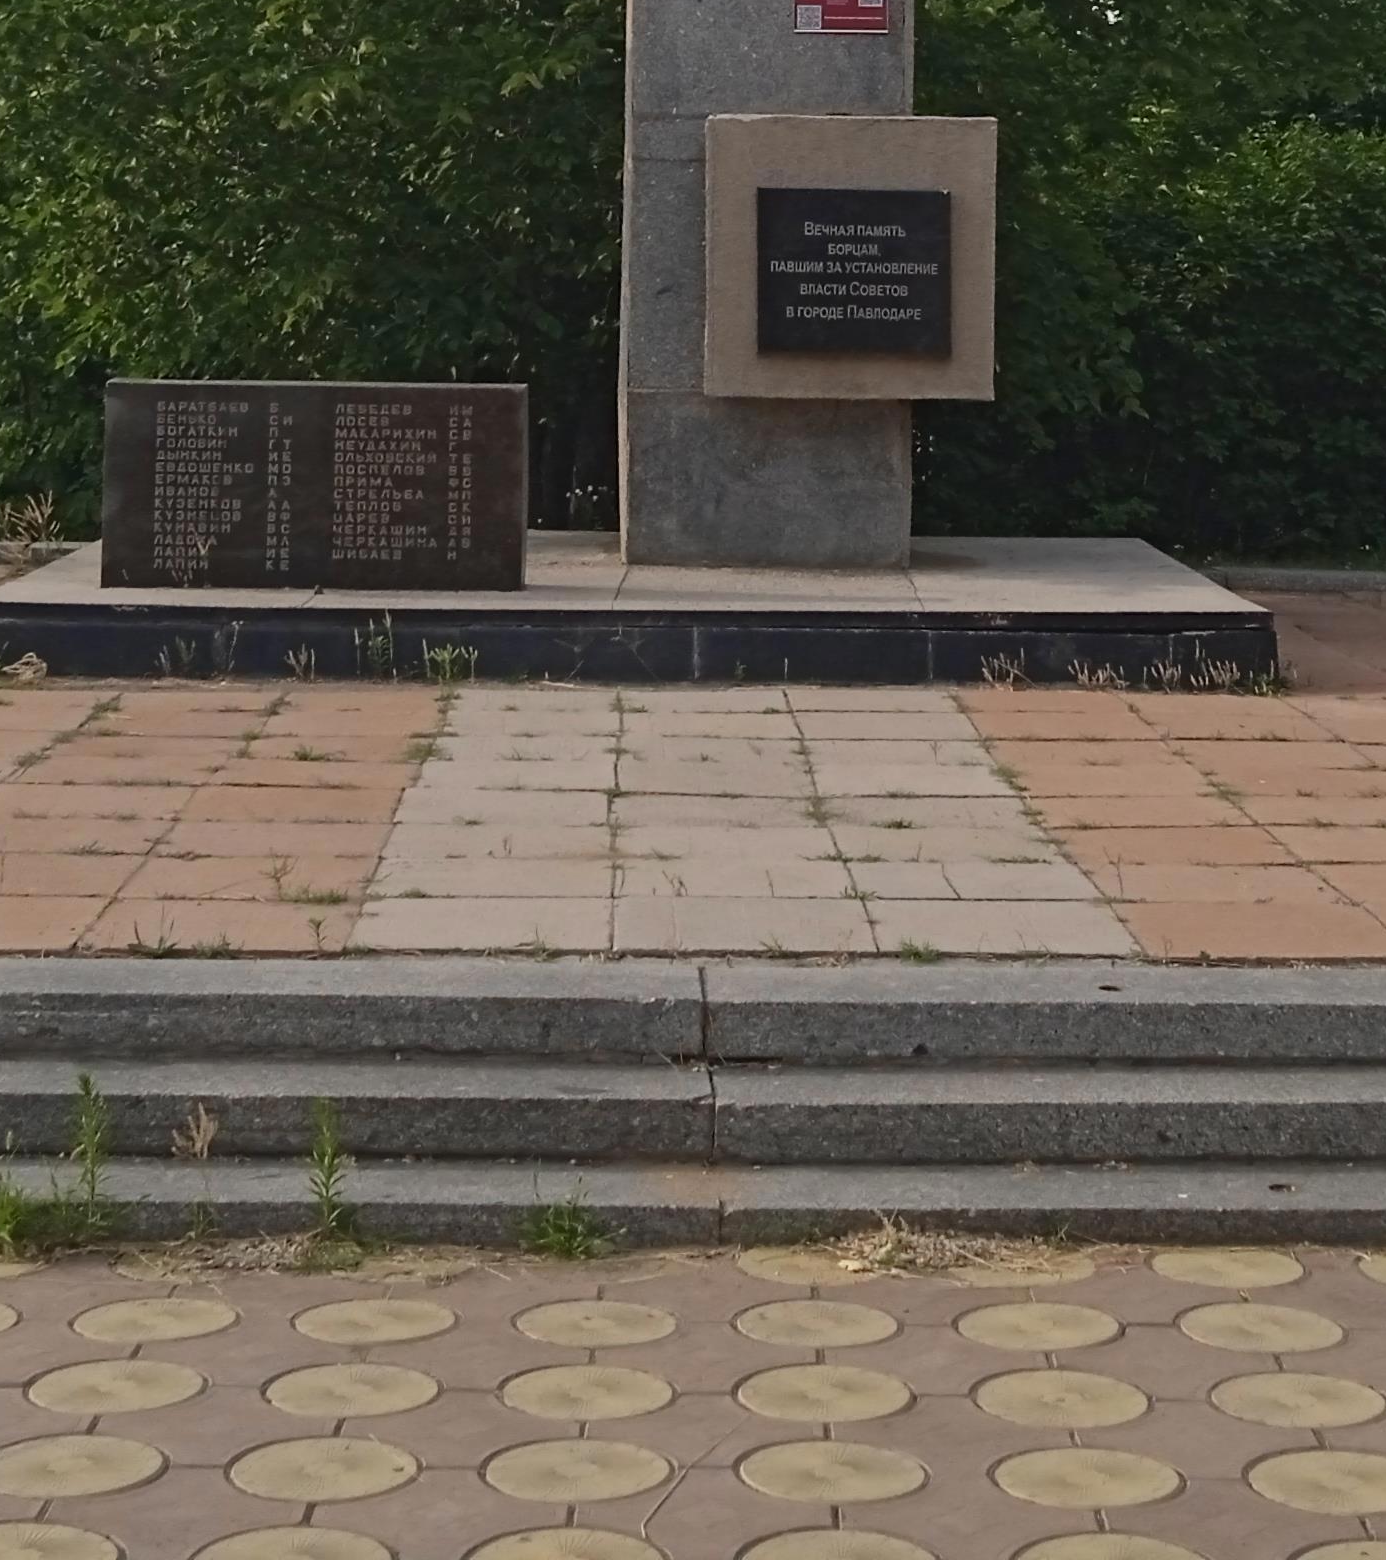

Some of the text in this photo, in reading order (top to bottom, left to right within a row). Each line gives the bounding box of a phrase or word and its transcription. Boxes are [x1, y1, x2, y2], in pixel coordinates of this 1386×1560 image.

[804, 222, 906, 237] ВЕЧНАЯ ПАМЯТЬ
[771, 261, 938, 275] ПАВШИМ ЗА УСТАНОВЛЕНИЕ
[800, 281, 908, 297] ВЛАСТИ СОВЕТОВ
[786, 305, 921, 321] В ГОРОДЕ ПАВЛОДАРЕ
[157, 401, 249, 412] БАРАТБАЕВ
[335, 404, 412, 415] ЛЕБЕДЕВ
[156, 414, 217, 424] БЕНЬКО
[335, 416, 389, 426] ЛОСЕВ
[156, 426, 238, 436] БОГАТКИН
[335, 428, 437, 439] МАКАРИХИН
[155, 438, 227, 448] ГОЛОВИН
[334, 440, 421, 451] НЕУДАХИН
[156, 451, 222, 460] ДЫНКИН
[155, 462, 254, 473] ЕВДОШЕНКО
[334, 465, 425, 476] ПОСПЕЛОВ
[334, 476, 393, 487] ПРИМА
[334, 489, 424, 499] СТРЕЛЬБА
[334, 501, 402, 512] ТЕПЛОВ
[333, 513, 389, 524] ЦАРЕВ
[333, 525, 427, 535] ЧЕРКАШИН
[333, 536, 437, 548] ЧЕРКАШИНА
[154, 546, 209, 557] ЛАПИ
[154, 559, 209, 569] ЛАПИН
